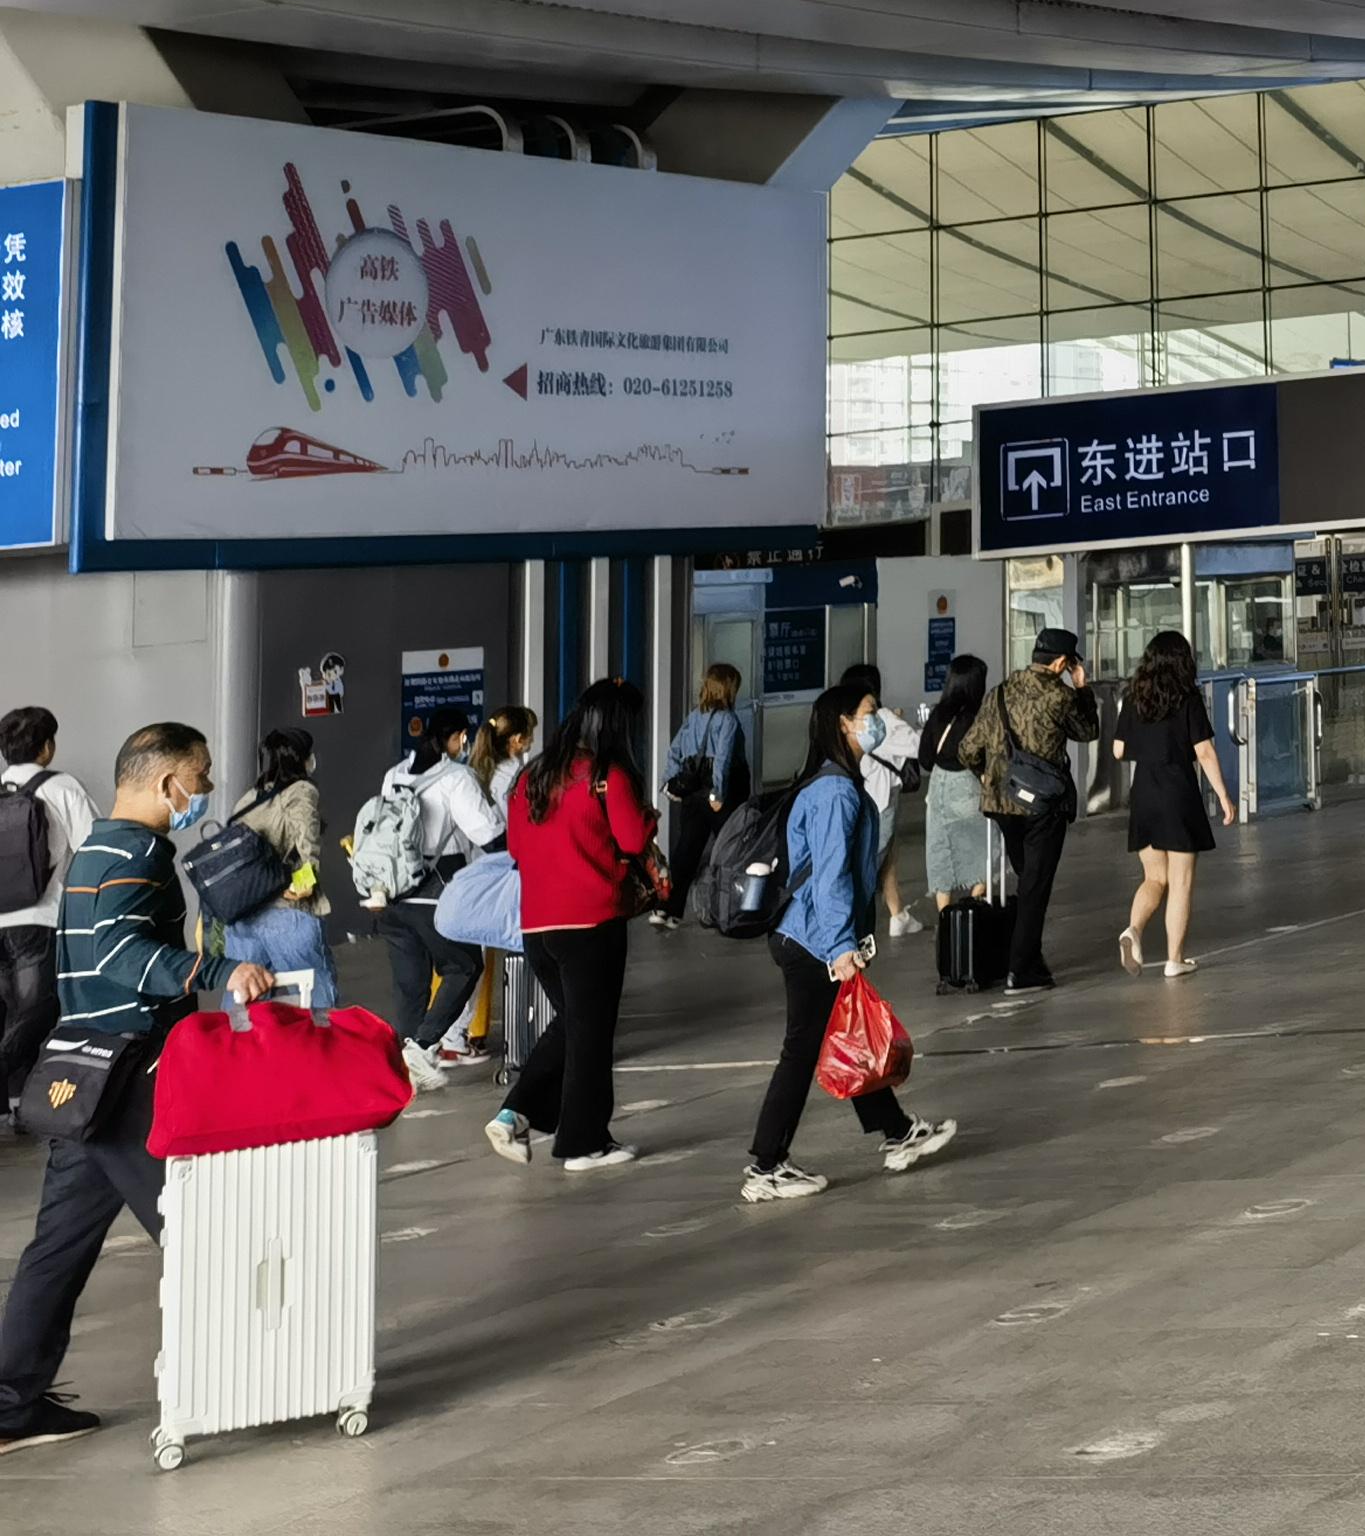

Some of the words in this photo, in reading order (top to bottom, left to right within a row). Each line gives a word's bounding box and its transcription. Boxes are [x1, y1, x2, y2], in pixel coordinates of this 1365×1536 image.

[4, 232, 26, 263] 凭
[360, 254, 400, 282] 高铁
[2, 269, 25, 301] 效
[338, 296, 418, 328] 广告媒体
[1077, 429, 1256, 486] 东进站口
[1080, 494, 1122, 513] East
[1127, 489, 1209, 509] Entrance
